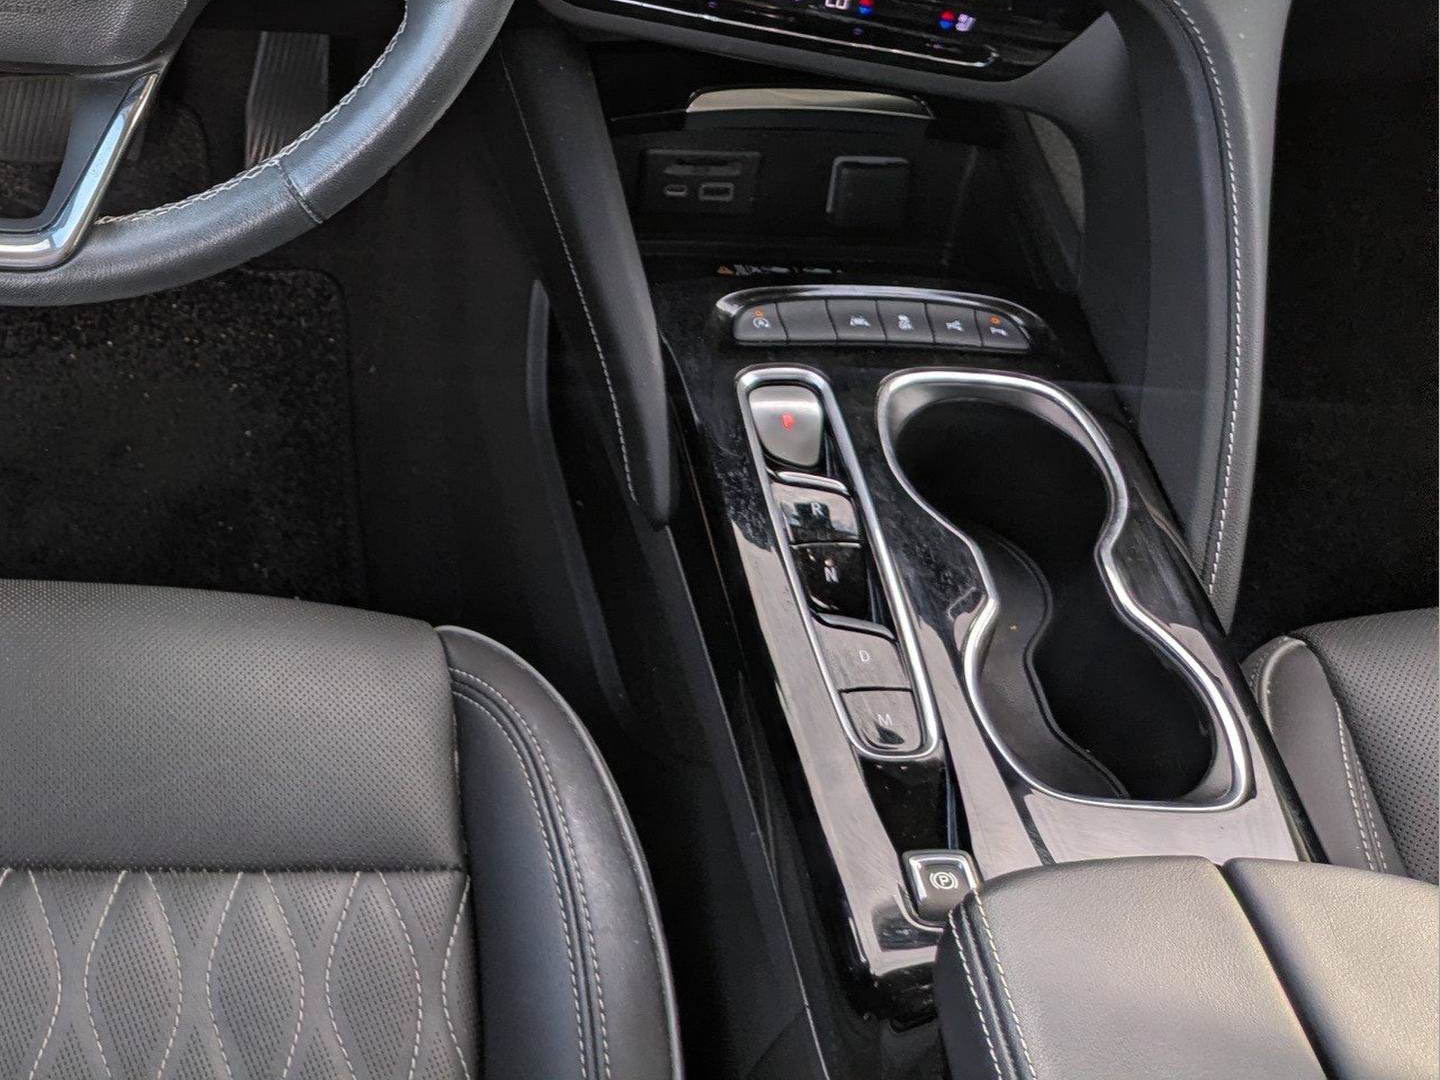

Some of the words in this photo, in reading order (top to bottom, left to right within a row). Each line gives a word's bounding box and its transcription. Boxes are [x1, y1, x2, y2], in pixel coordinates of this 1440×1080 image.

[781, 411, 795, 430] P
[811, 502, 823, 517] R
[824, 565, 840, 584] N
[859, 648, 871, 663] D
[876, 712, 893, 727] M
